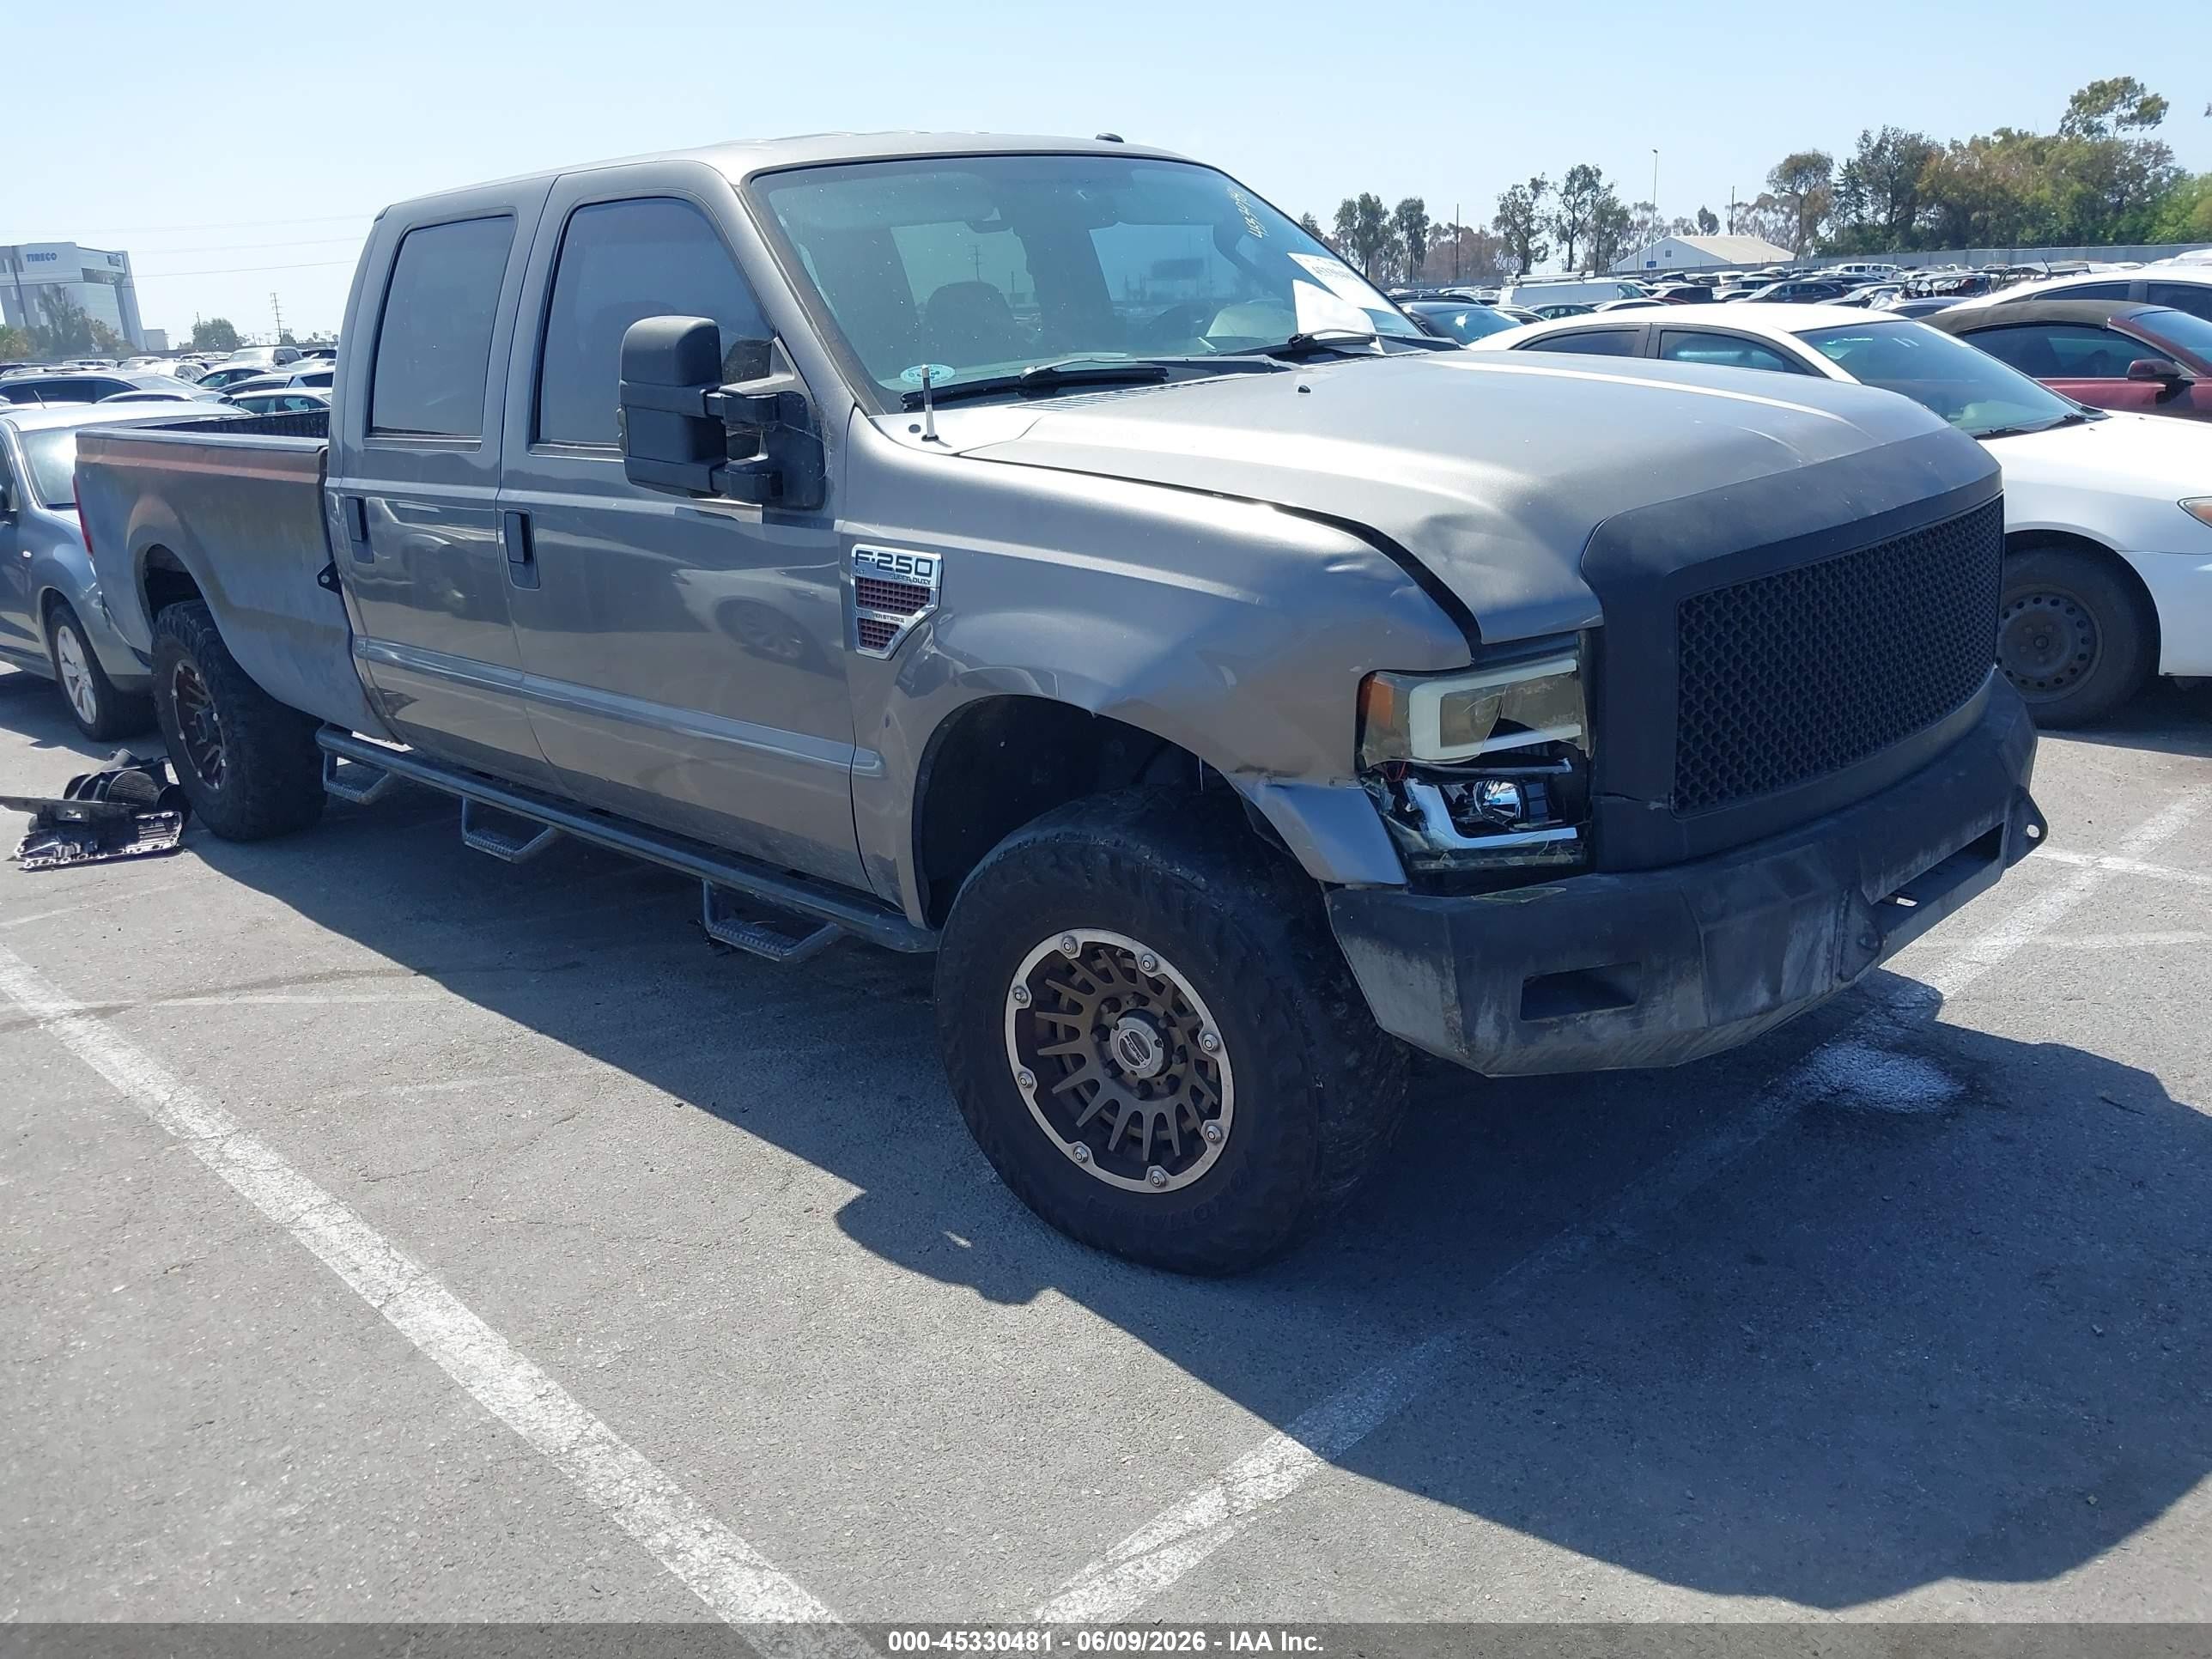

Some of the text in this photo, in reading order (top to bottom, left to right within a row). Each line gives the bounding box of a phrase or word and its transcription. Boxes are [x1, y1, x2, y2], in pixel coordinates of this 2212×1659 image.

[855, 550, 933, 578] F-250
[889, 574, 932, 586] SUPER DUTY
